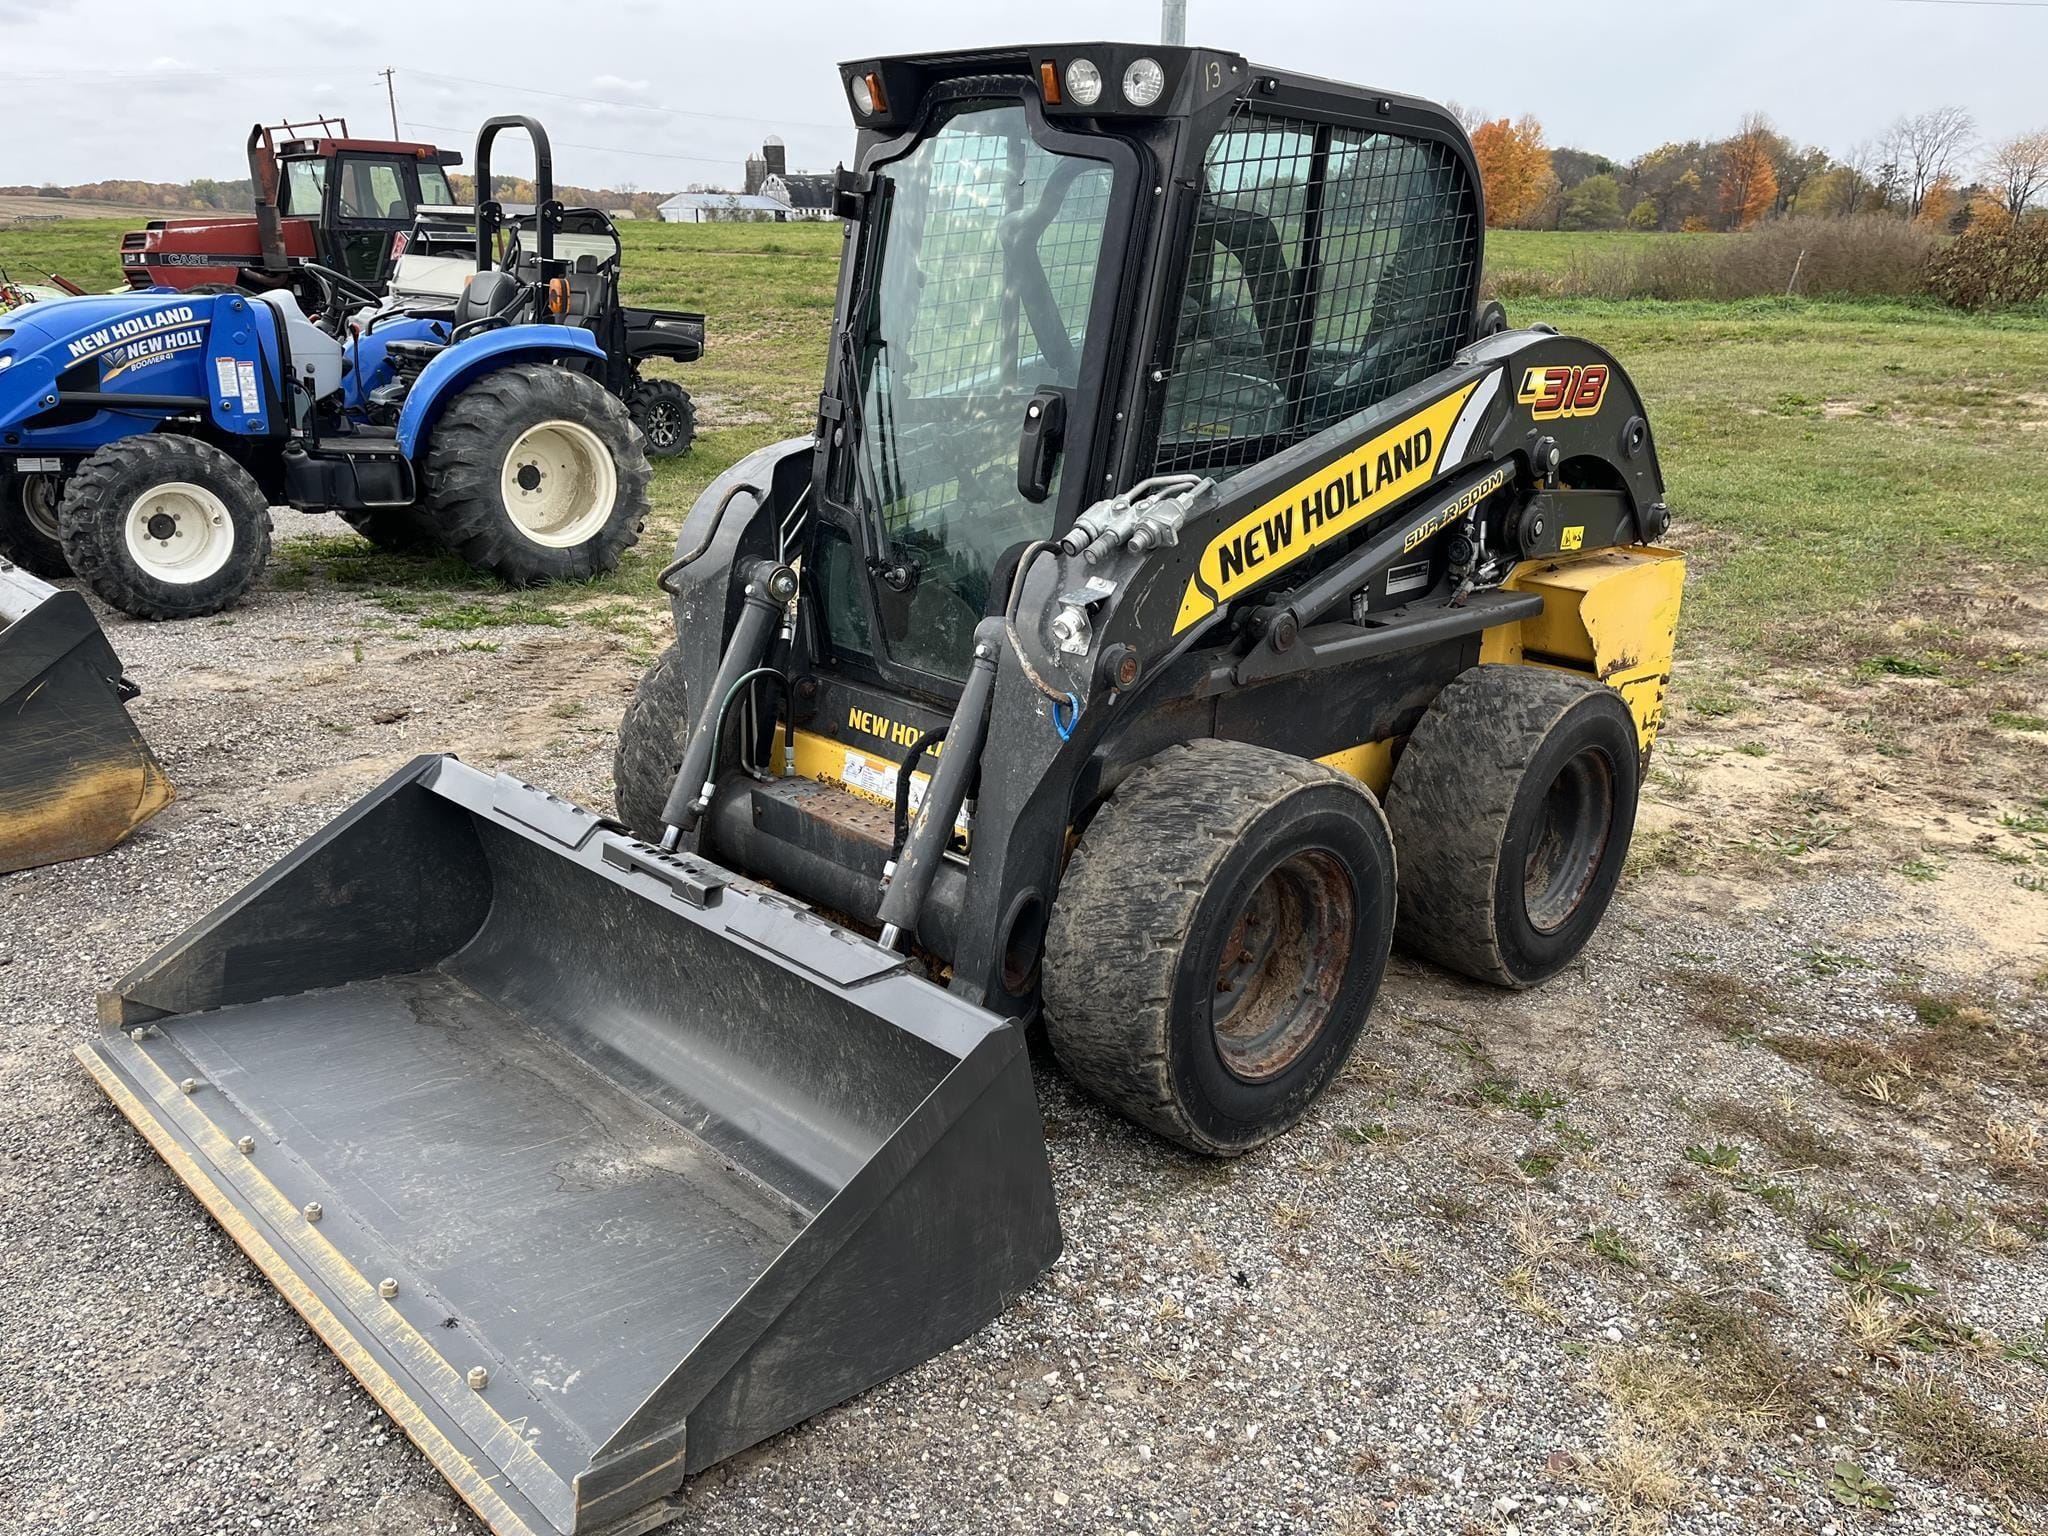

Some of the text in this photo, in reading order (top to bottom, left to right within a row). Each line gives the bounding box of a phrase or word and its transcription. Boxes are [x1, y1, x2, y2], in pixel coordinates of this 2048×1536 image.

[1205, 61, 1221, 92] 13
[168, 253, 209, 266] CASE
[67, 306, 193, 358] NEW HOLLAND
[126, 335, 162, 360] NEW
[1218, 426, 1432, 585] NEW HOLLAND
[1459, 469, 1503, 515] BOOM
[848, 707, 890, 739] NEW
